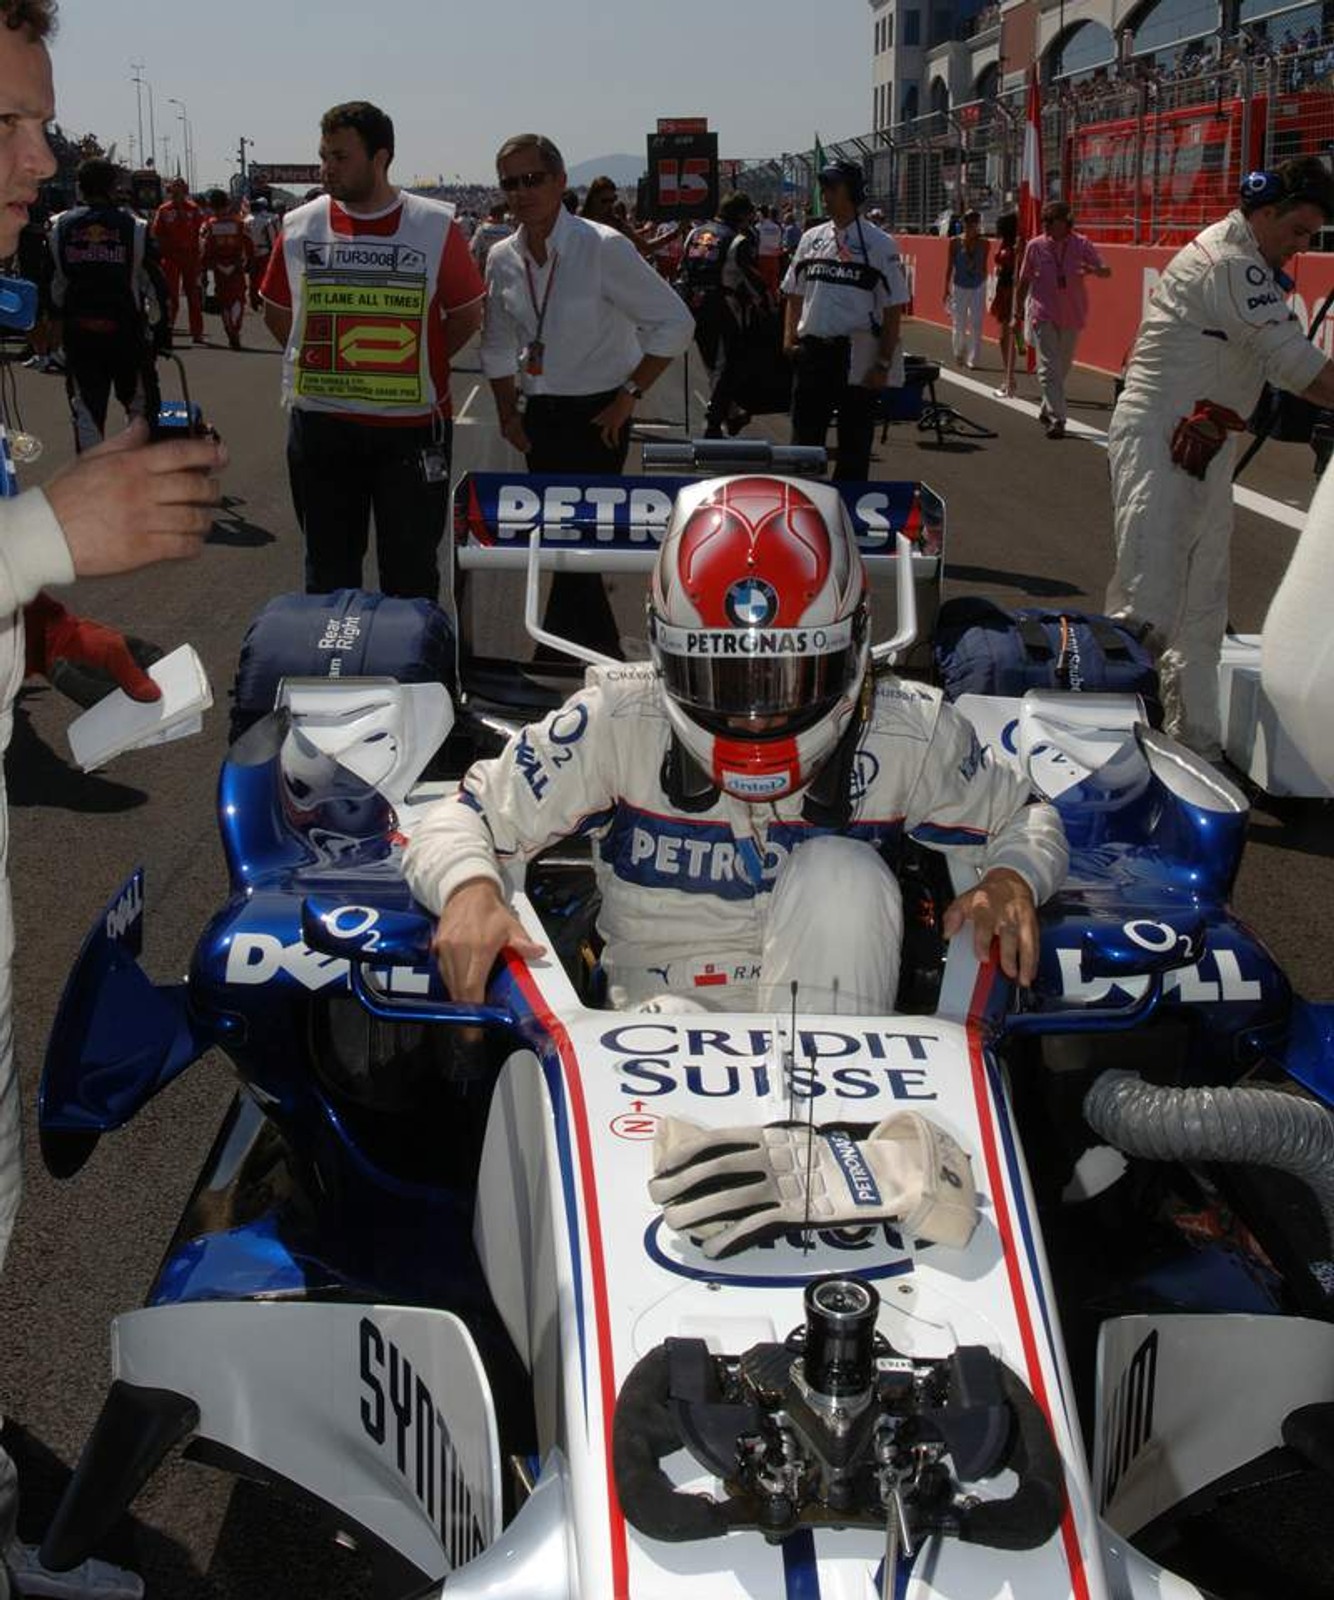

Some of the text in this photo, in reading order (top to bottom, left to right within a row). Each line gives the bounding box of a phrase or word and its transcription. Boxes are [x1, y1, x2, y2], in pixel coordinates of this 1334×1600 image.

[325, 293, 354, 305] LANE
[358, 294, 379, 306] ALL
[497, 485, 890, 546] PETRS
[318, 618, 340, 649] Rear
[336, 615, 361, 650] Right
[687, 633, 807, 653] PETRONAS
[631, 826, 789, 882] PETRO
[620, 1058, 938, 1101] SUISSE
[829, 1130, 877, 1201] PETRONAS
